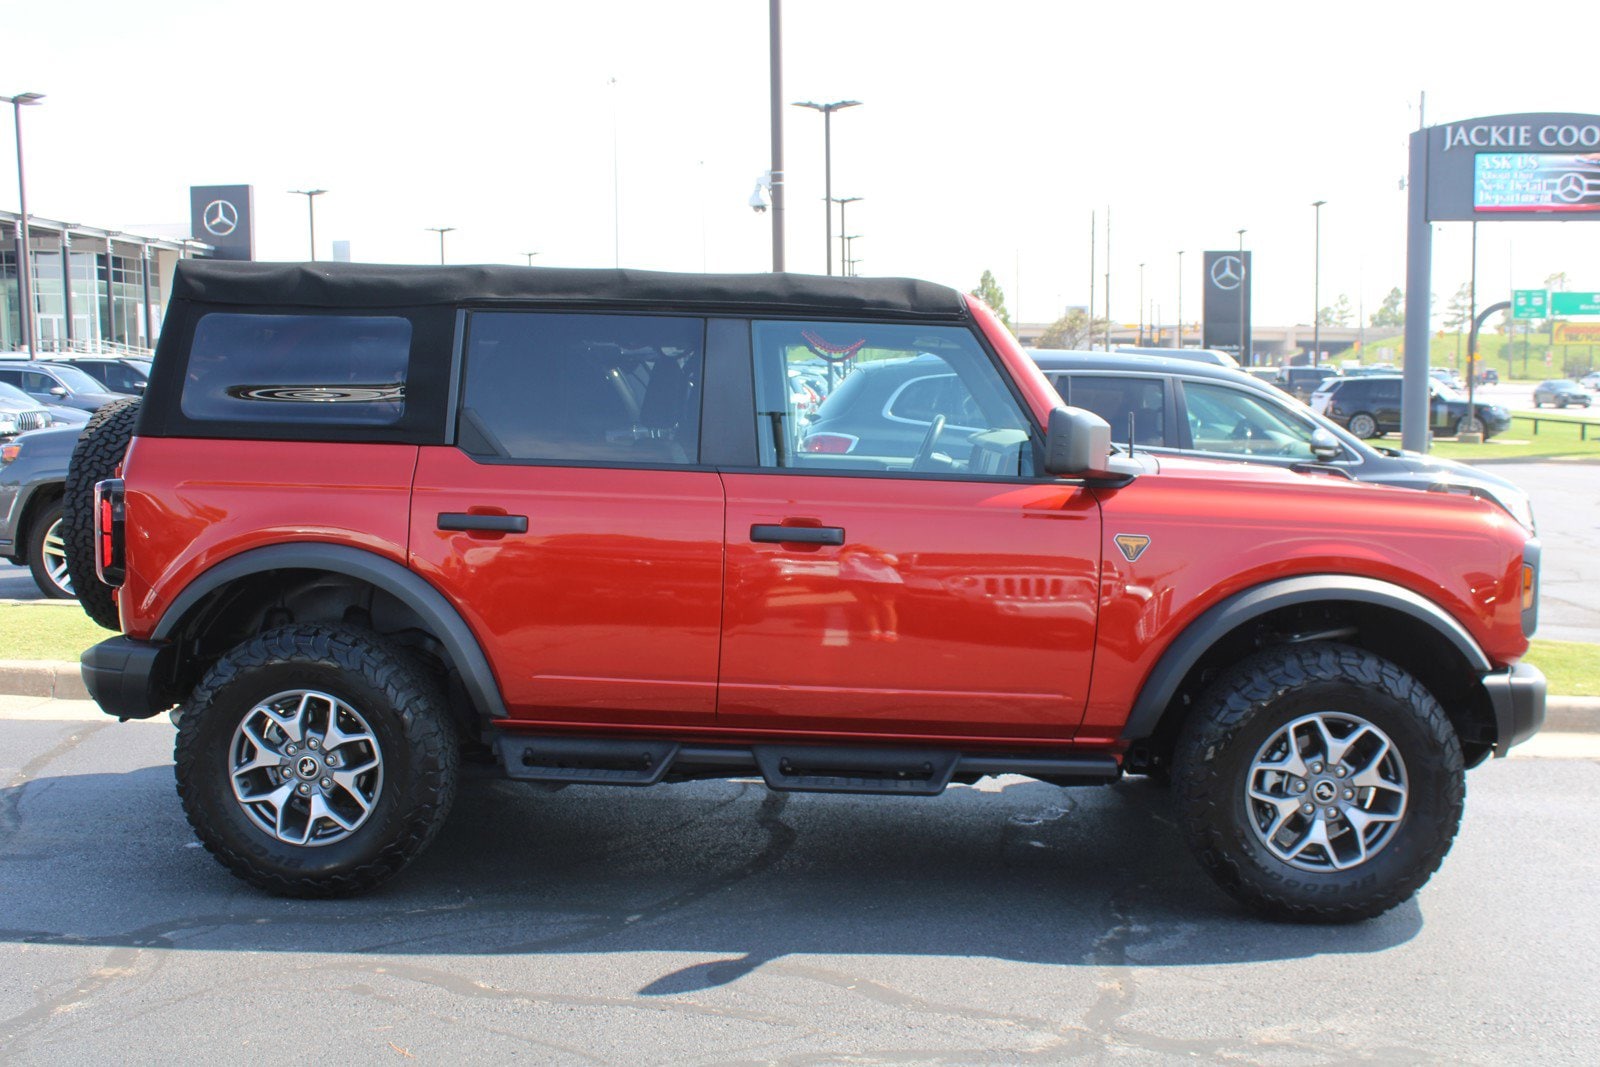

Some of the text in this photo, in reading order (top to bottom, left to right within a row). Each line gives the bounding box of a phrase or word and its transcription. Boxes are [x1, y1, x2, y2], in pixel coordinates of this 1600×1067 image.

[1444, 125, 1600, 151] JACKIE COO
[1481, 155, 1539, 170] ASK US
[1479, 179, 1547, 191] New Detail
[1479, 191, 1553, 204] Department
